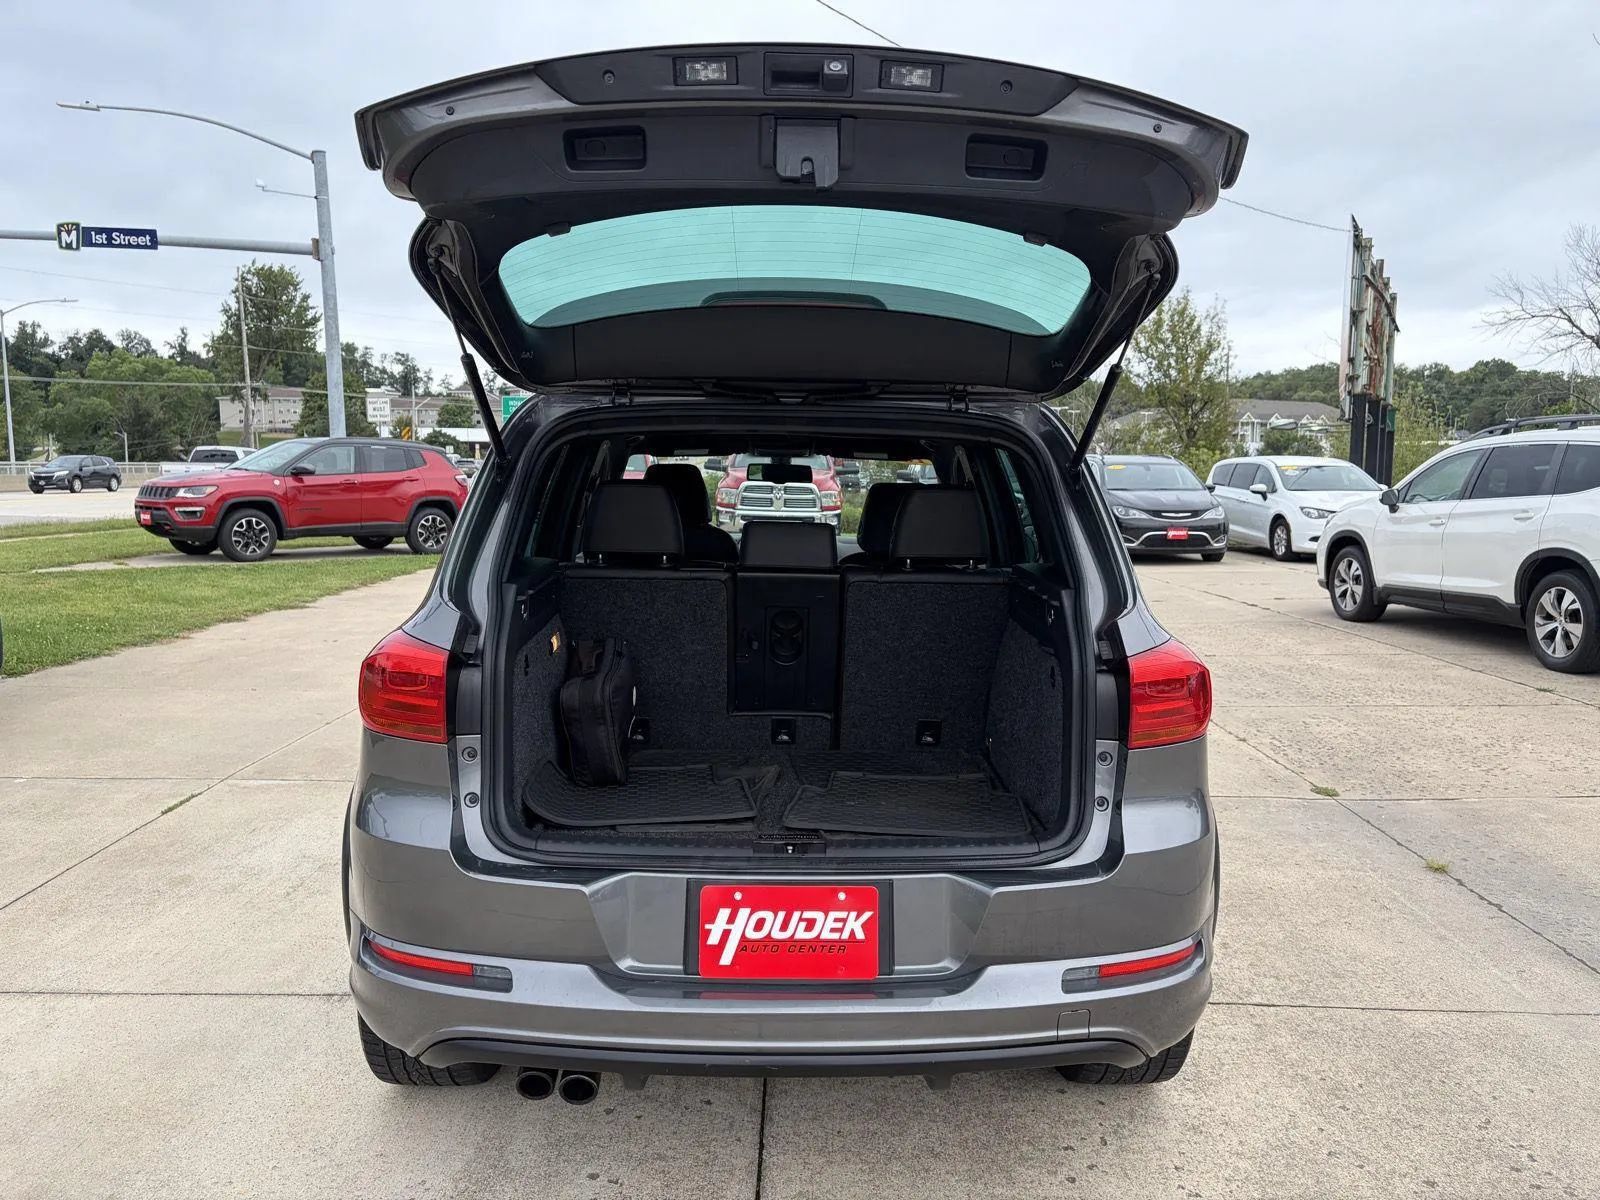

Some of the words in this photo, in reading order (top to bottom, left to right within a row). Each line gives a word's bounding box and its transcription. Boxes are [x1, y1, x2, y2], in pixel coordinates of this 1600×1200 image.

[60, 230, 77, 249] M
[91, 231, 107, 244] 1st
[111, 231, 151, 246] Street
[704, 907, 874, 966] HOUDEK
[739, 944, 781, 954] AUTO
[787, 944, 847, 954] CENTER
